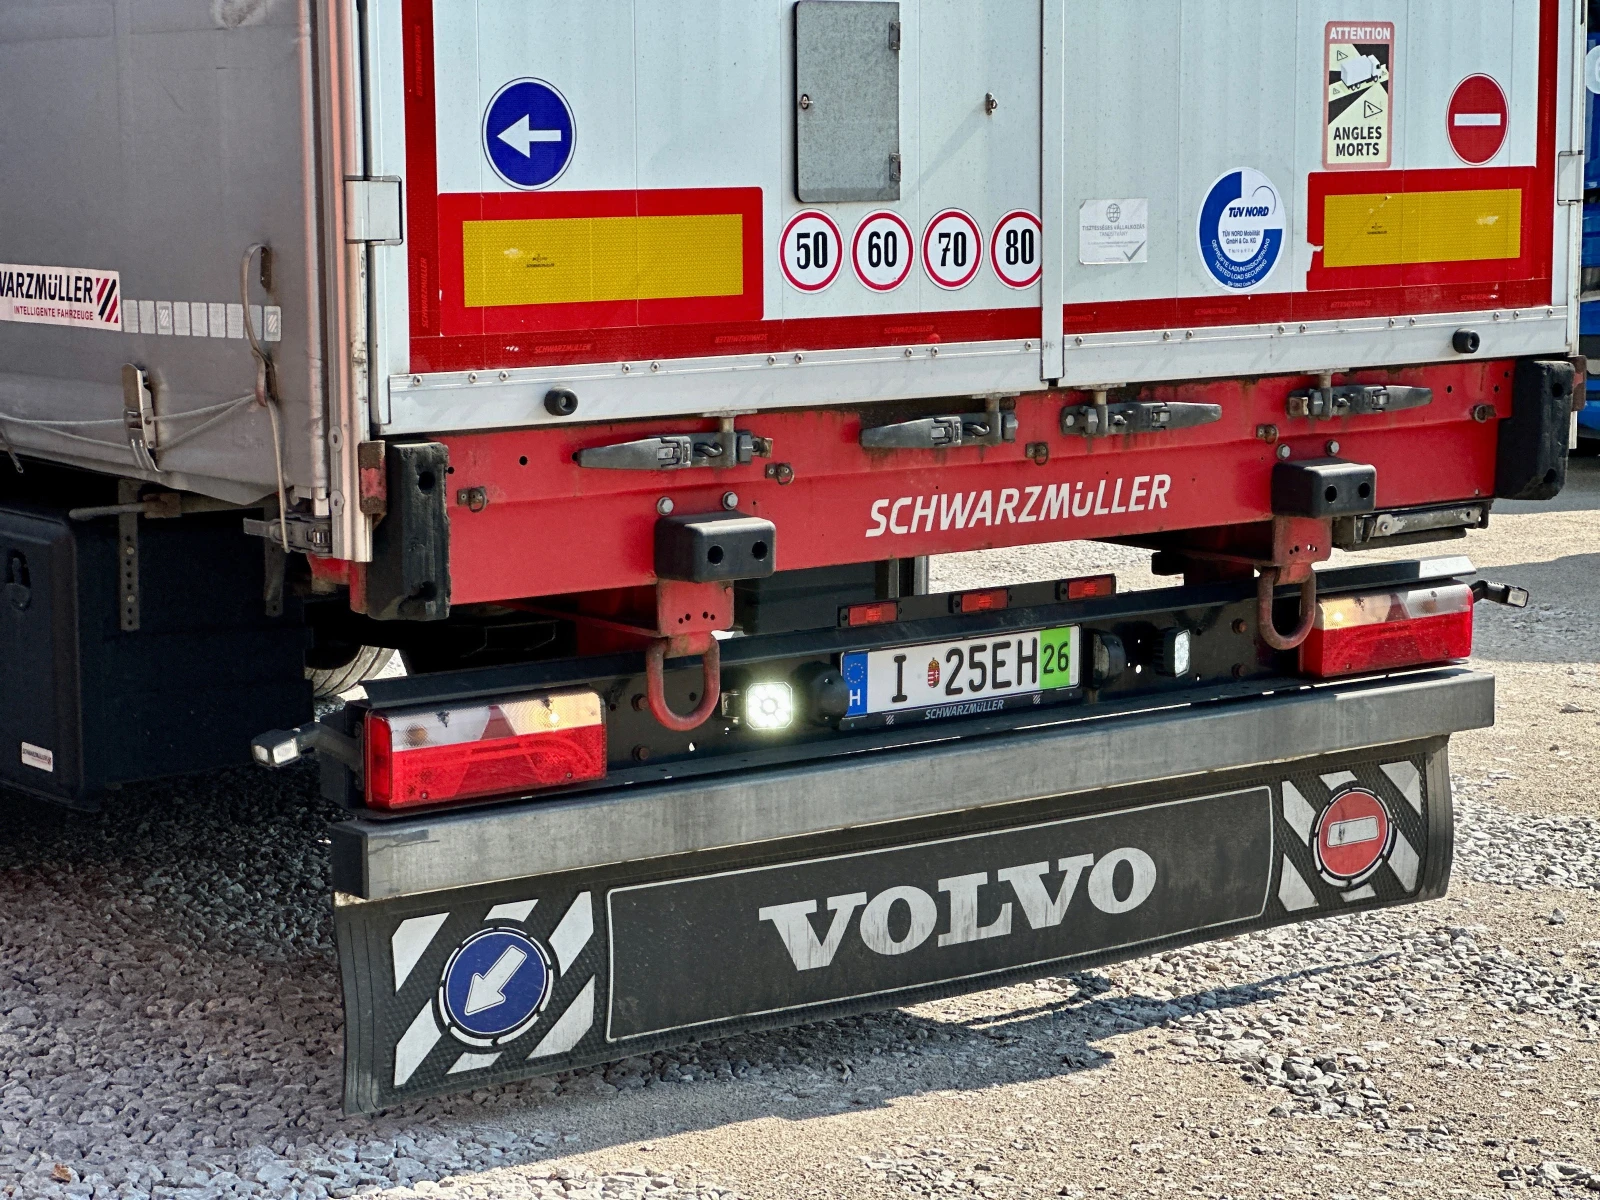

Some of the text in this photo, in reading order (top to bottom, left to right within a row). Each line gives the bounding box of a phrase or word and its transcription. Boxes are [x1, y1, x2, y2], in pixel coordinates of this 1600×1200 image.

[1329, 27, 1391, 40] ATTENTION
[1333, 126, 1383, 140] ANGLES
[1335, 142, 1380, 156] MORTS
[1228, 206, 1270, 218] TÜV NORD
[796, 231, 828, 269] 50
[868, 230, 898, 268] 60
[938, 231, 967, 267] 70
[1005, 228, 1035, 265] 80
[1214, 259, 1268, 280] TESTED LOAD SECURING
[14, 305, 94, 320] INTELLIGENTE FAHRZEUGE
[865, 474, 1171, 538] SCHWARZMÜLLER
[945, 637, 1038, 696] 25EH
[1043, 641, 1069, 674] 26
[849, 689, 861, 707] H
[925, 699, 1005, 720] SCHWARZMÜLLER
[758, 847, 1157, 971] VOLVO
